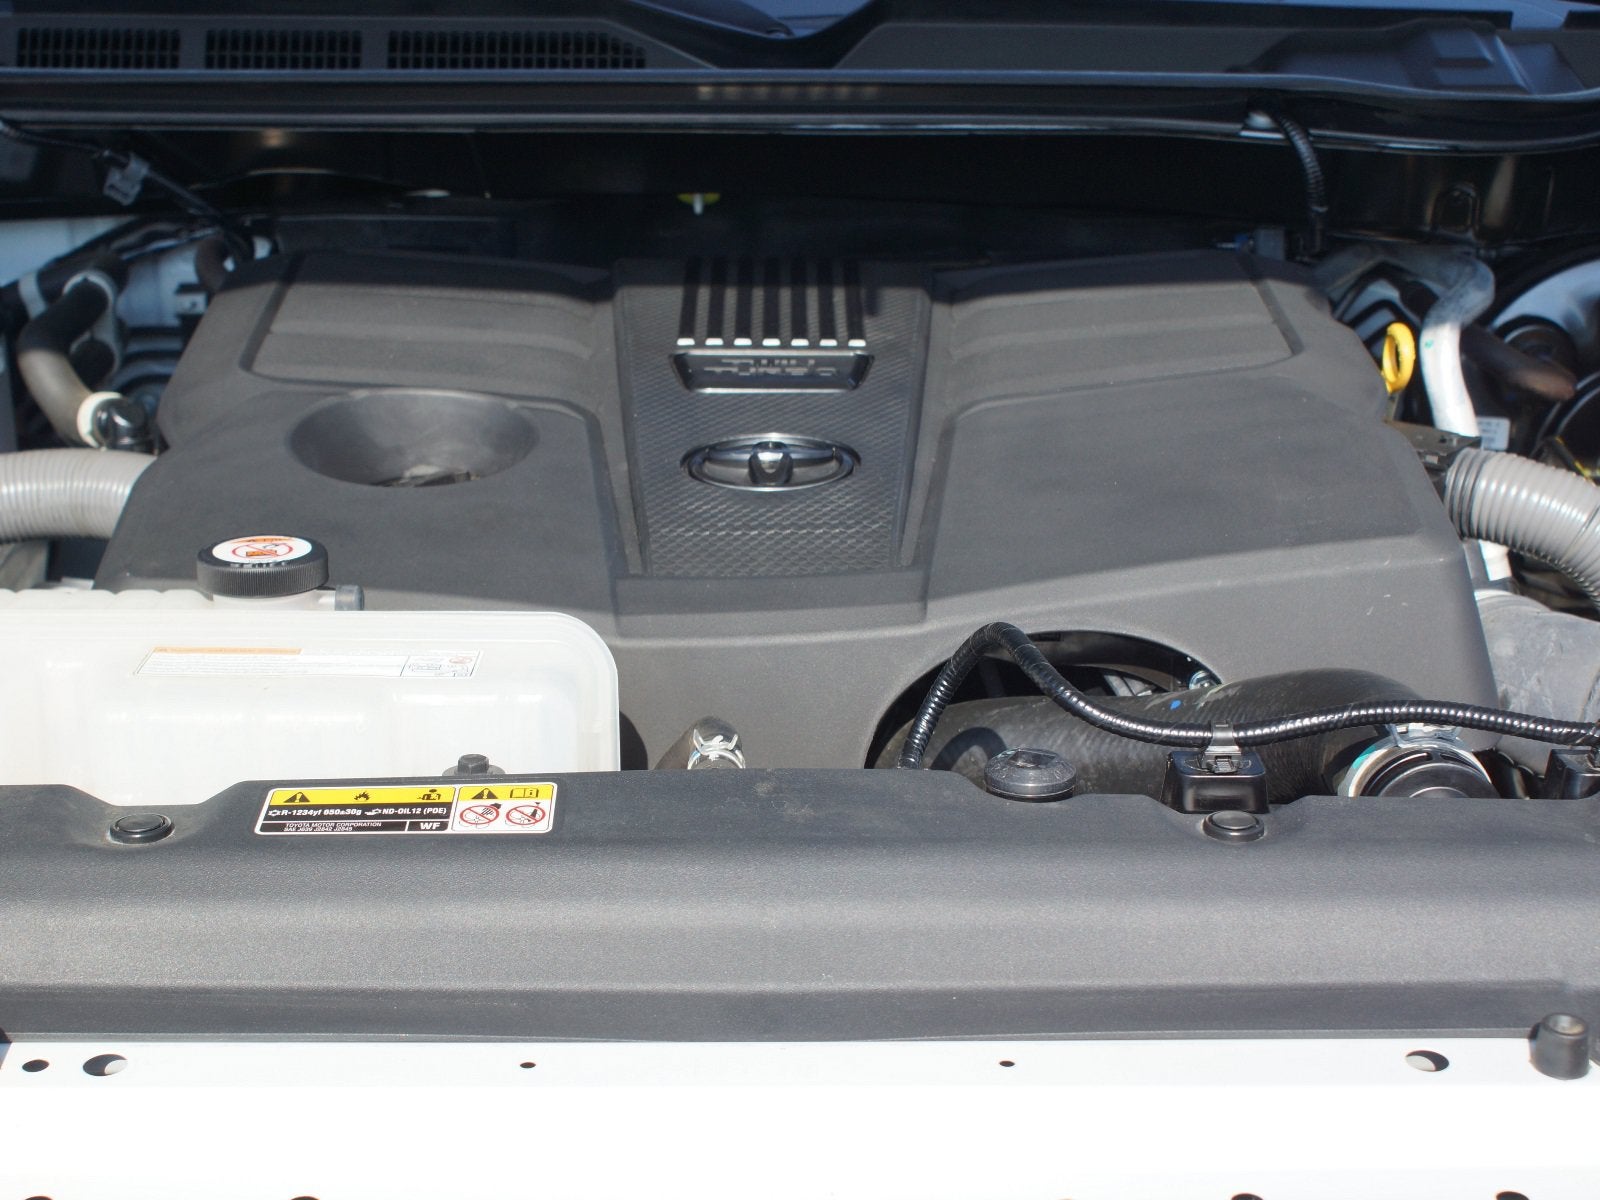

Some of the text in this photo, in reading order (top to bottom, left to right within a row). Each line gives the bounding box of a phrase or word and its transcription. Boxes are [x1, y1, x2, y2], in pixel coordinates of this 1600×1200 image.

[382, 807, 447, 815] ND-OIL12 (POE)
[420, 822, 440, 830] WF
